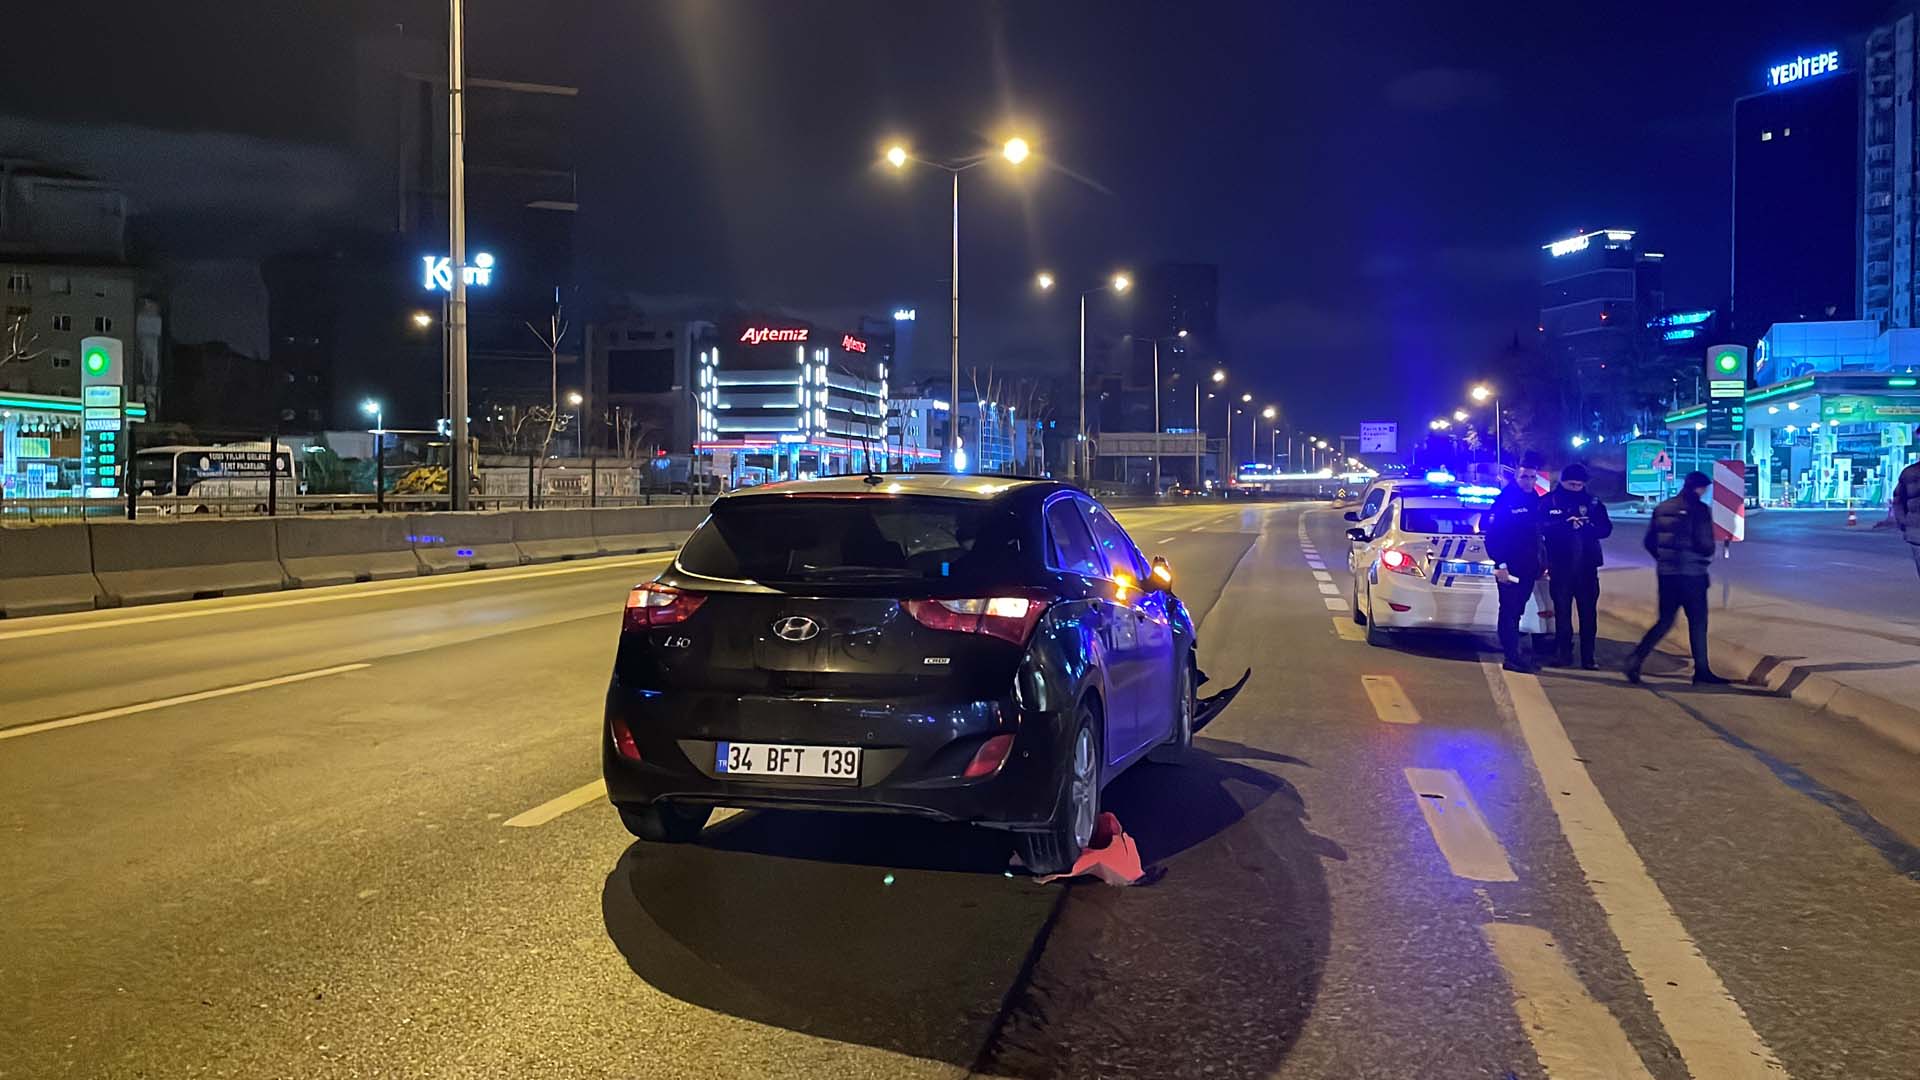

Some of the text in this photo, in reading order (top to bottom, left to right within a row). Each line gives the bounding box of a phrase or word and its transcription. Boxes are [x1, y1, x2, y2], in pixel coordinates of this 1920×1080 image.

[1770, 51, 1839, 86] YEDİTEPE
[740, 327, 809, 345] Aytemiz
[718, 746, 857, 775] TR 34 BFT 139
